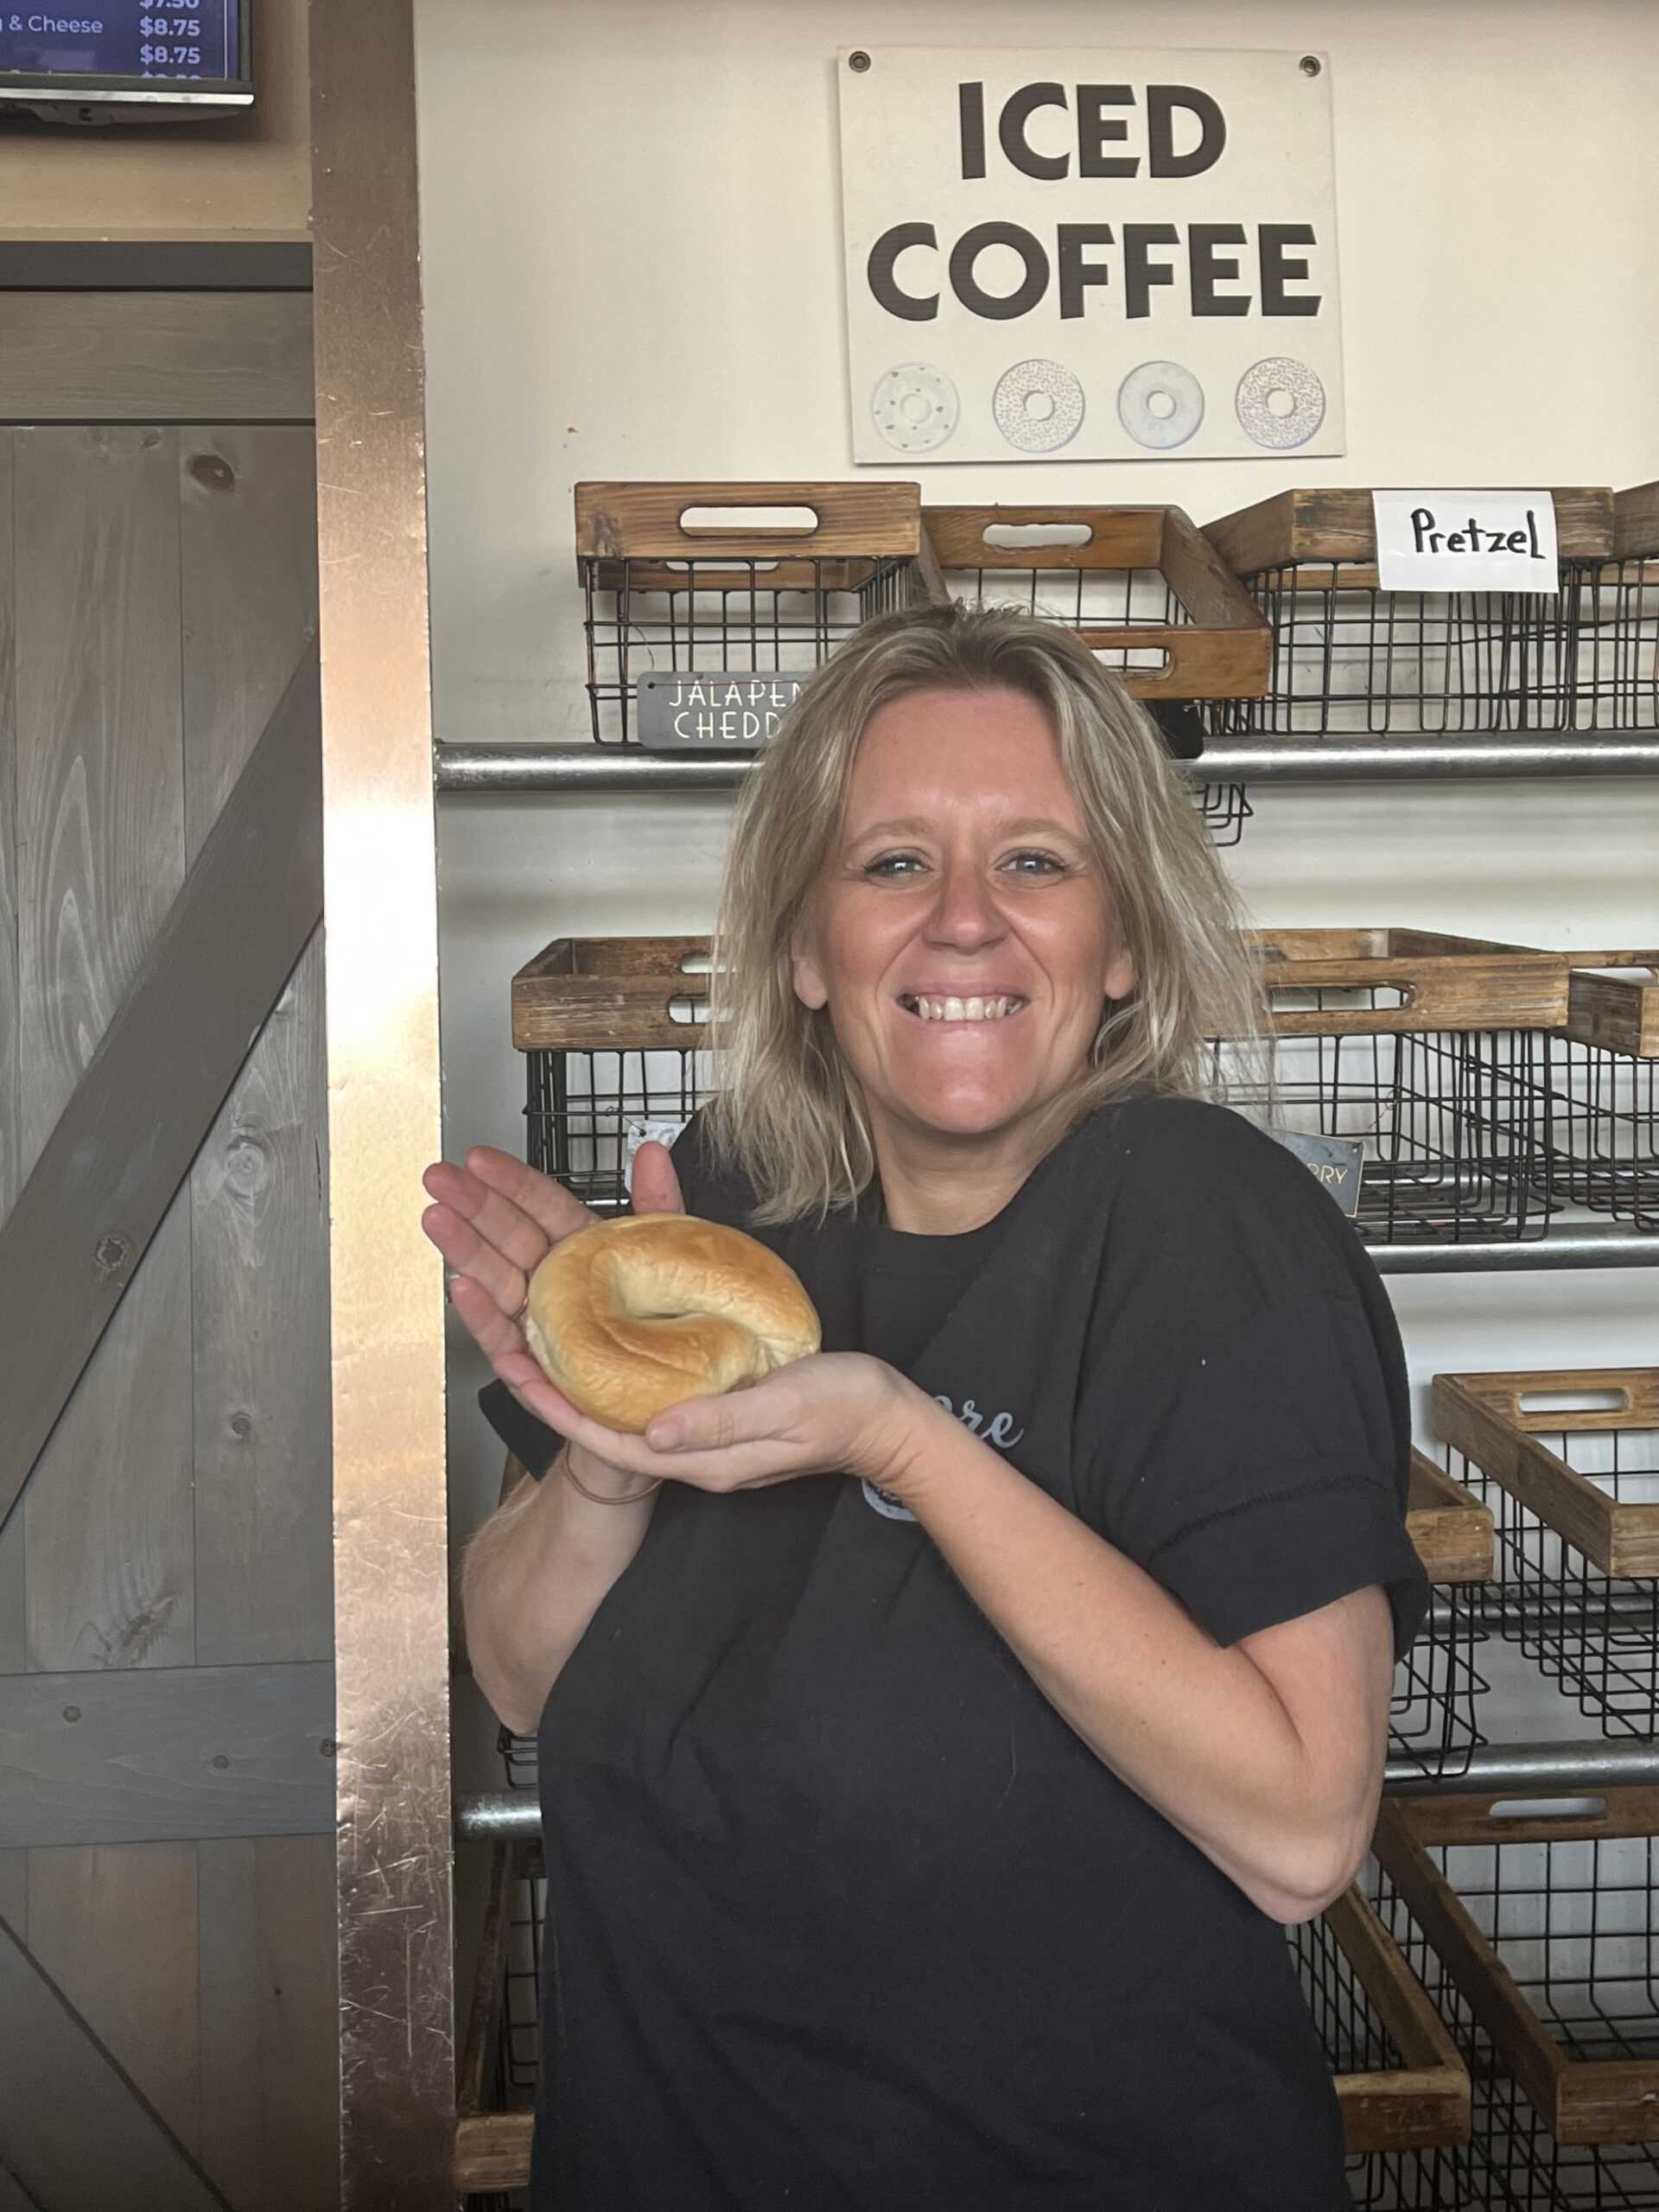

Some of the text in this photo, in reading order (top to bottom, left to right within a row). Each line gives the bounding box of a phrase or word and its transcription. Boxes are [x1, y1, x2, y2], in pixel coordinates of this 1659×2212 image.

[9, 15, 22, 31] &
[28, 15, 103, 33] Cheese
[140, 16, 200, 37] $8.75
[140, 44, 200, 65] $8.75
[959, 81, 1226, 180] ICED
[867, 221, 1322, 321] COFFEE
[1410, 508, 1547, 559] Pretzel
